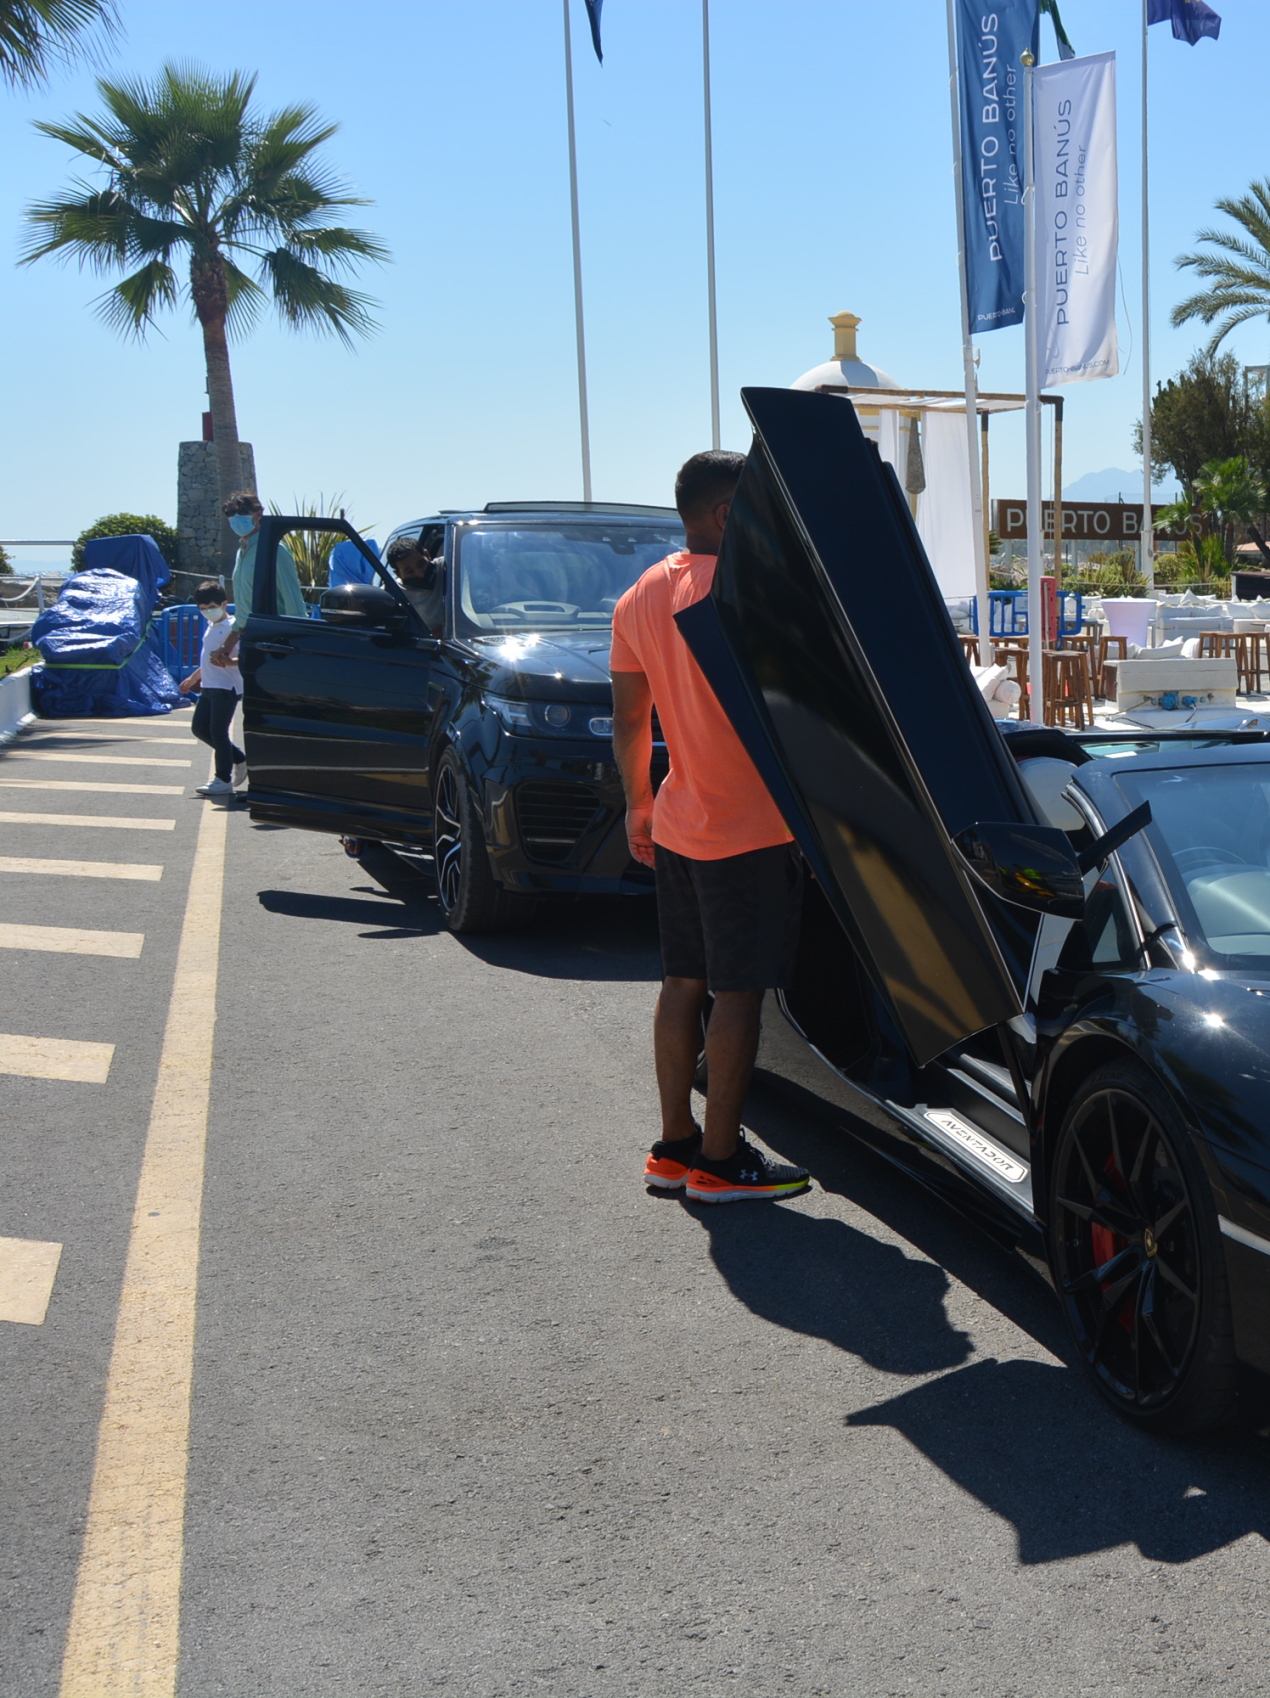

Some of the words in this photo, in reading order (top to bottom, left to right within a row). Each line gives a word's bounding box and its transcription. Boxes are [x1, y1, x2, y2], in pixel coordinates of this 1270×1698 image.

[978, 13, 999, 123] BANÚS
[1002, 63, 1017, 121] other
[1007, 128, 1016, 155] no
[1053, 99, 1072, 198] BANÚS
[1003, 163, 1019, 205] Like
[1073, 144, 1087, 196] other
[981, 136, 1003, 261] PUERTO
[1075, 203, 1086, 228] no
[1054, 210, 1070, 325] PUERTO
[1072, 235, 1089, 275] Like
[1006, 508, 1111, 534] PERTO
[941, 1119, 1015, 1172] AVENTADOR
